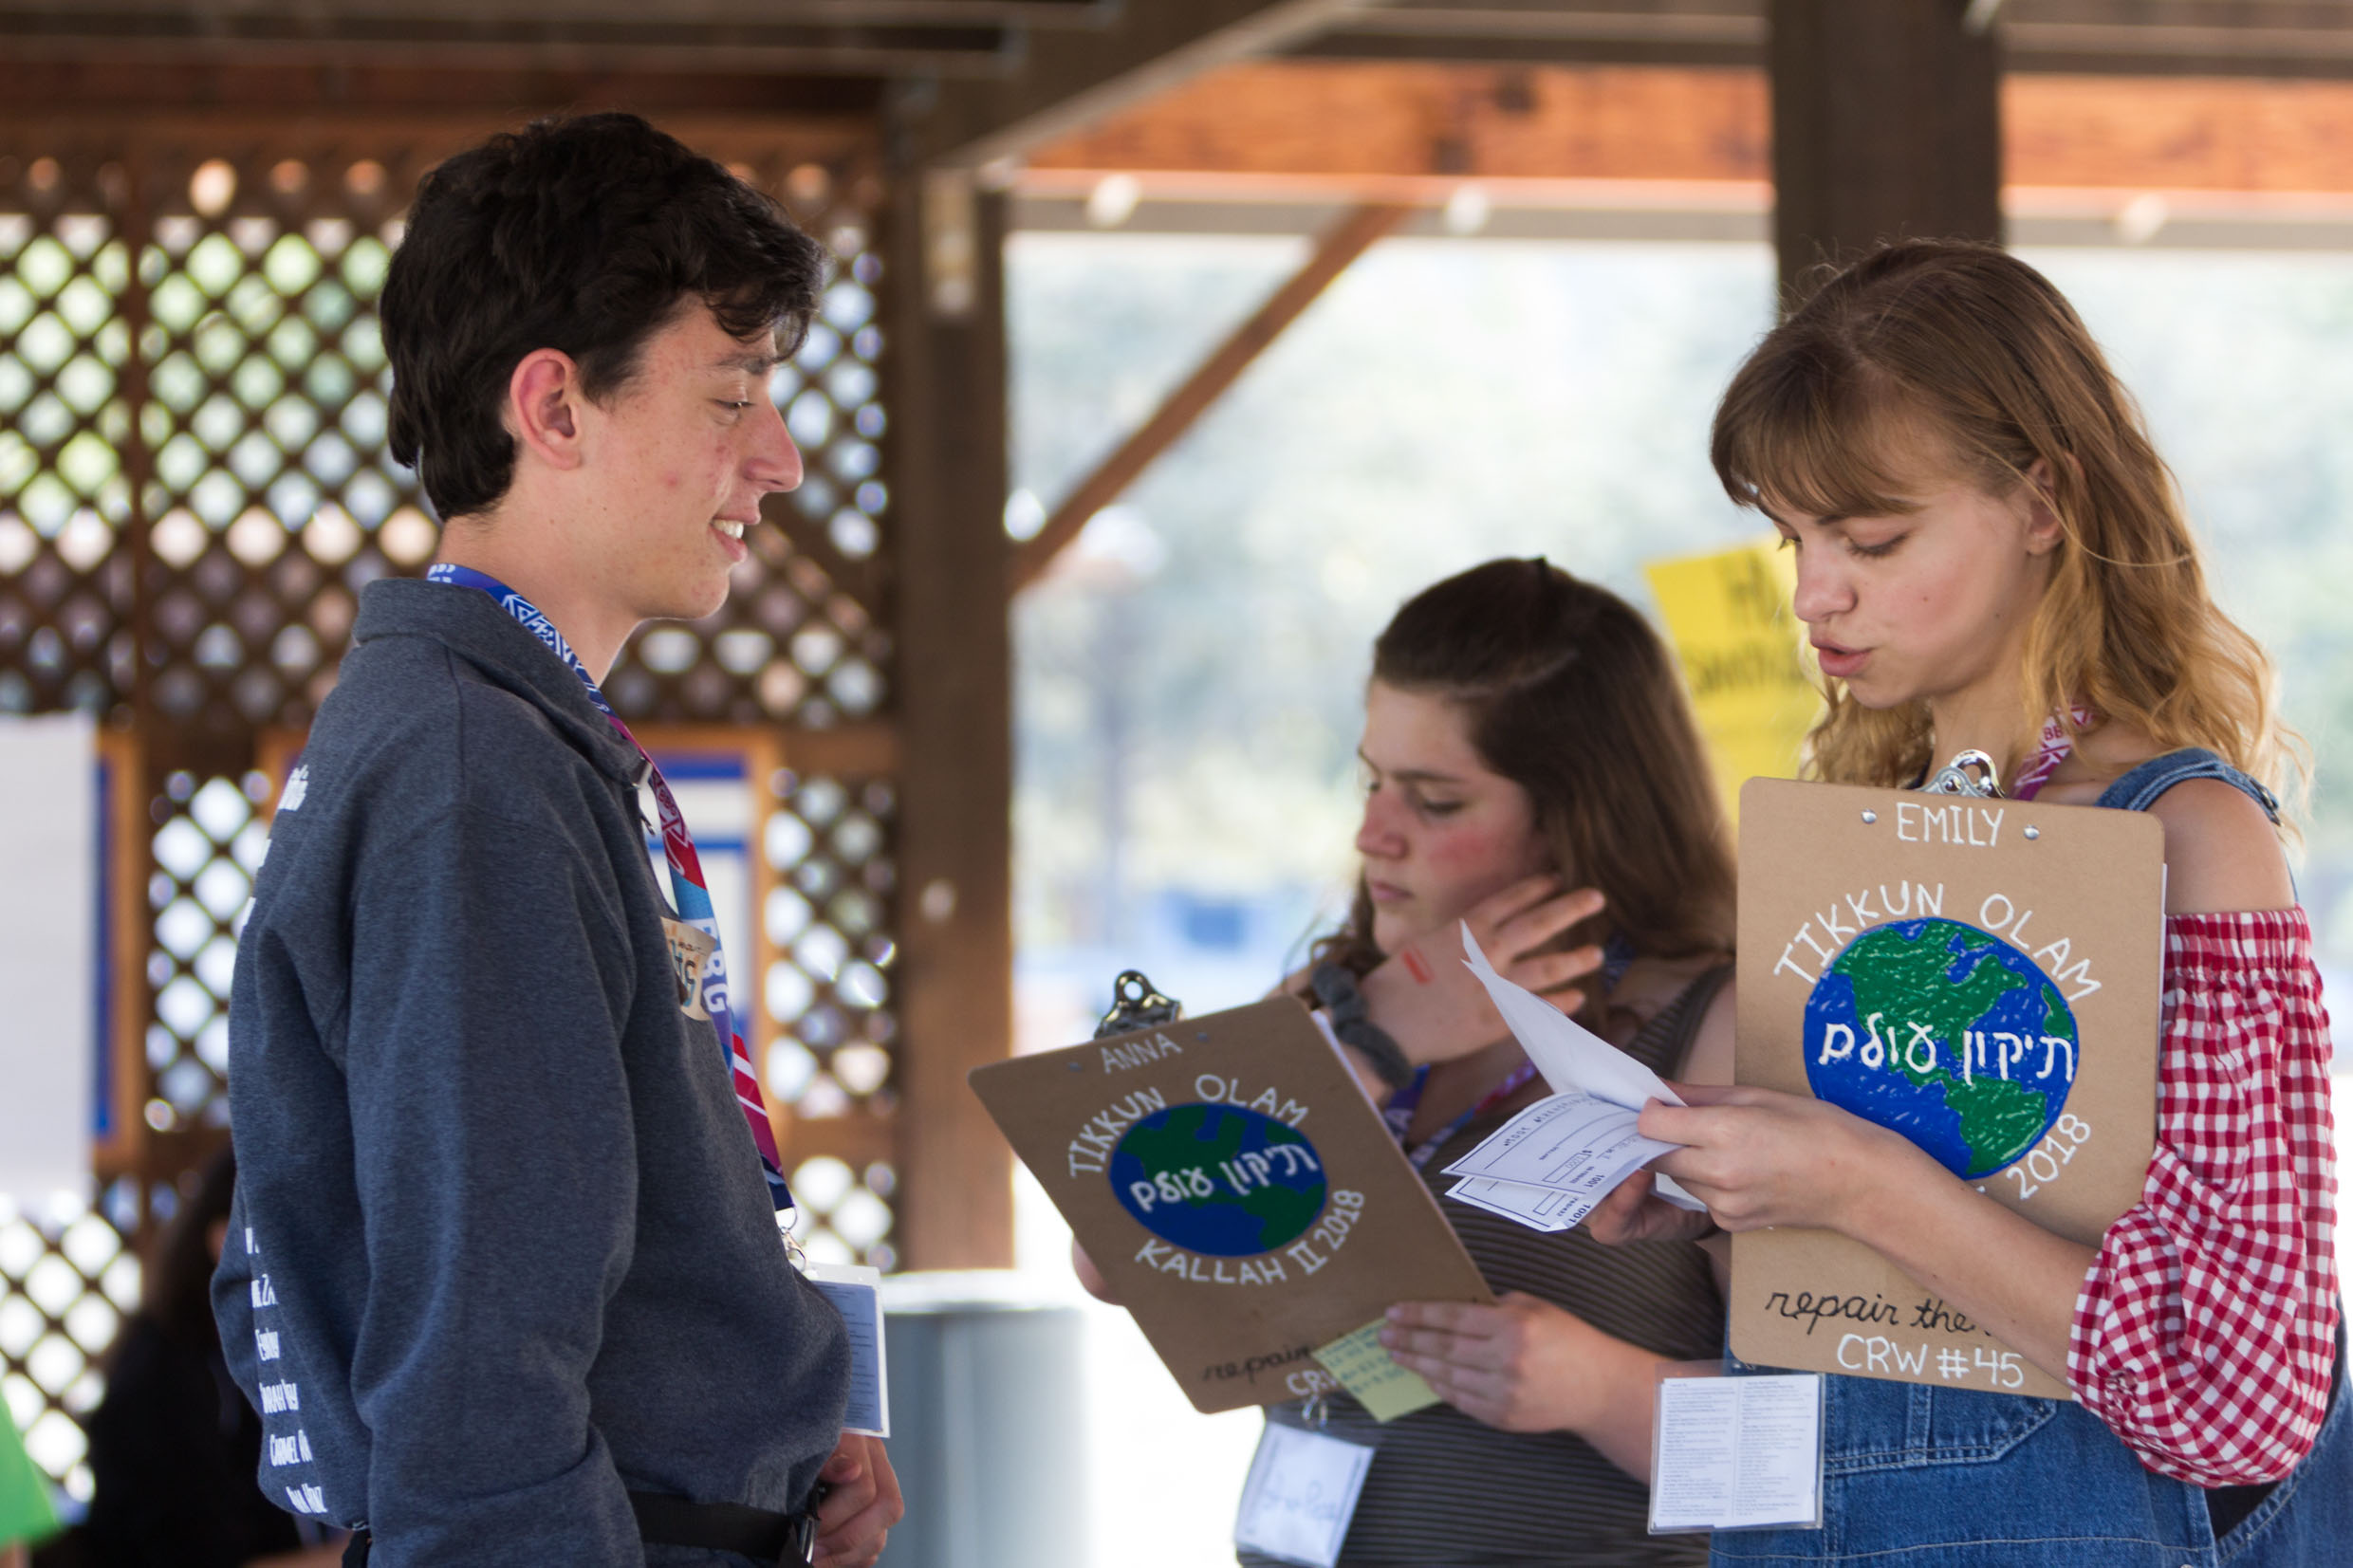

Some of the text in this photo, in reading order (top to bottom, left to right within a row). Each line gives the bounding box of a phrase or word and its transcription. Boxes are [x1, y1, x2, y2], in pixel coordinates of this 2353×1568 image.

[1897, 802, 2004, 846] EMILY
[1773, 879, 2101, 1002] TIKKUN OLAM
[1101, 1031, 1182, 1074] ANNA
[1818, 1012, 2073, 1085] תיקון עולם
[1068, 1074, 1308, 1178] TIKKUN OLAM
[2006, 1113, 2091, 1200] 2018
[1129, 1143, 1319, 1212] תיקון עולם
[1135, 1190, 1364, 1284] KALLAH II 2018
[1568, 1204, 1590, 1224] 1001
[1765, 1291, 1976, 1336] repair the
[1203, 1344, 1311, 1384] repair
[1837, 1333, 2025, 1390] CRW #45
